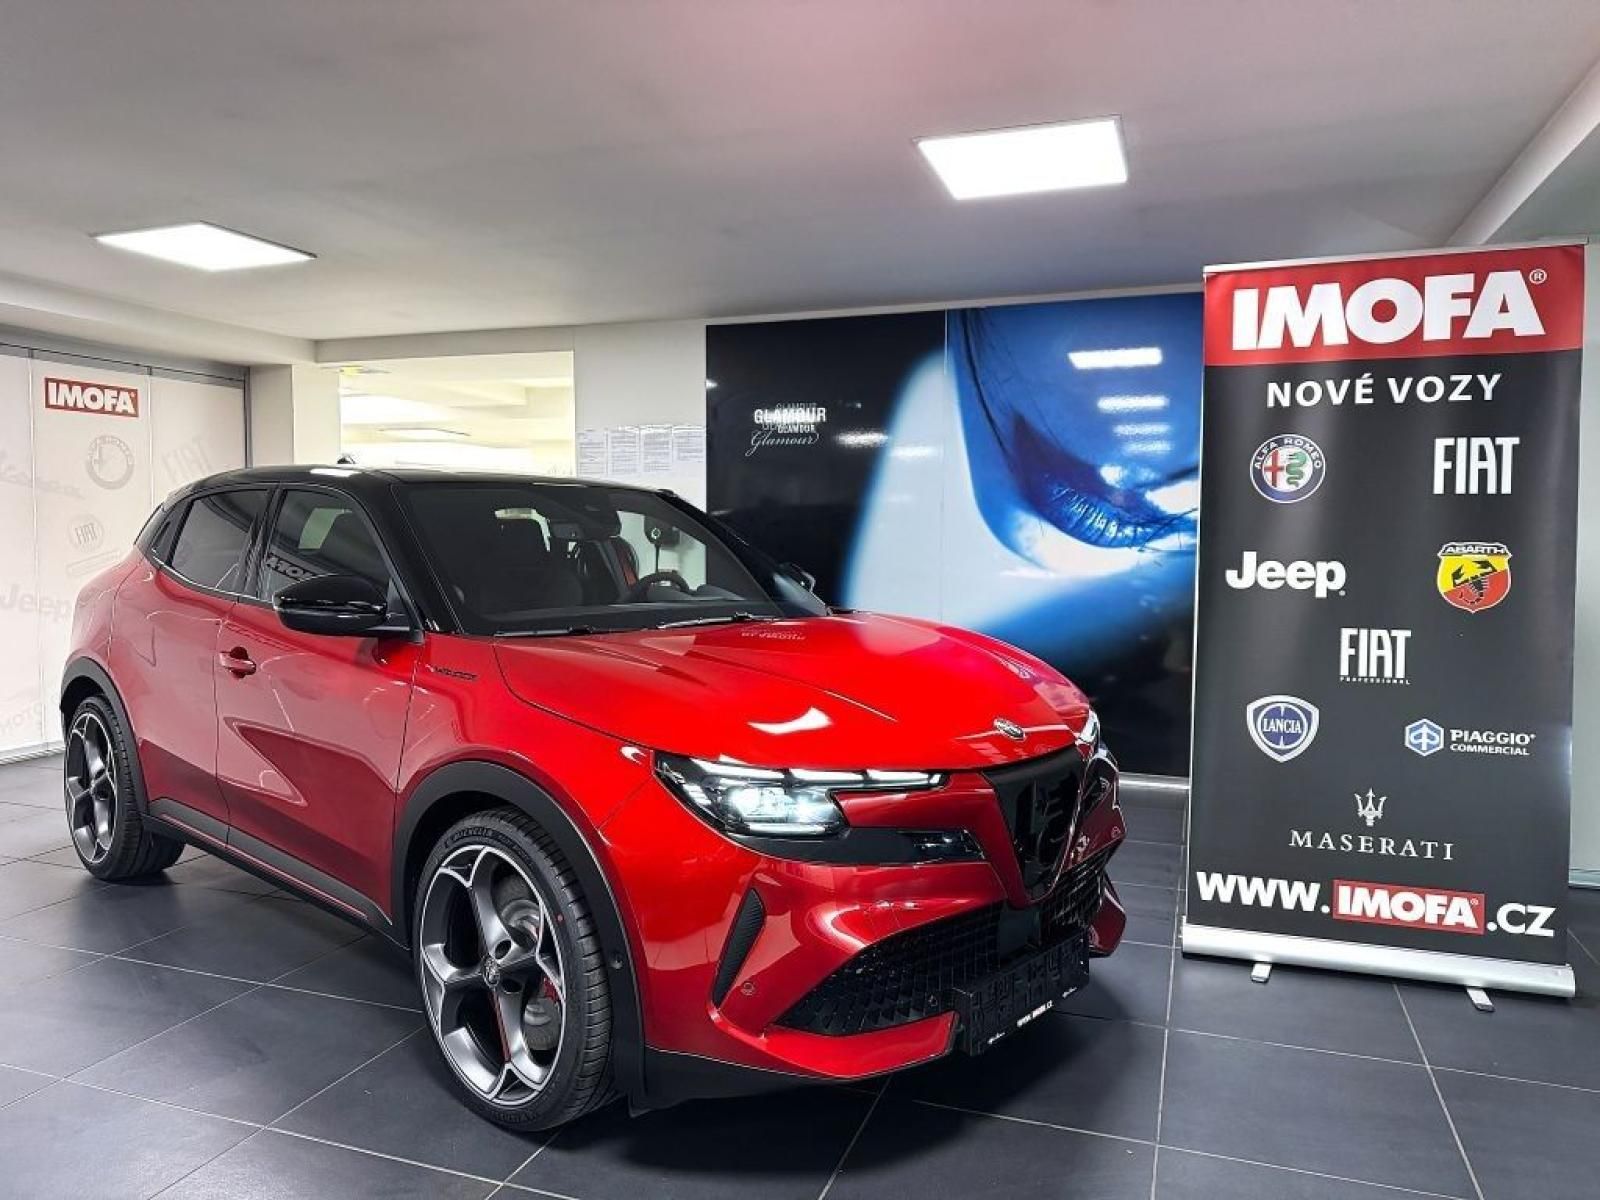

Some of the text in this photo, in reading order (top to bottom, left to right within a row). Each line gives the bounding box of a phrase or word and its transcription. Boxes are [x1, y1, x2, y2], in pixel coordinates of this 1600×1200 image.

[1232, 269, 1547, 350] IMOFA
[48, 382, 137, 414] IMOFA
[1266, 373, 1502, 408] NOVÉ VOZY
[754, 407, 826, 423] GLAMOUR
[1254, 437, 1322, 469] ALFA ROMEO
[1432, 436, 1520, 495] FIAT
[1446, 545, 1505, 555] ABARTH
[1225, 551, 1346, 598] Jeep
[1340, 627, 1412, 678] FIAT
[1263, 718, 1302, 733] LANCIA
[1450, 729, 1531, 745] PIAGGIO
[1450, 743, 1531, 756] COMMERCIAL
[1288, 829, 1454, 861] MASERATI
